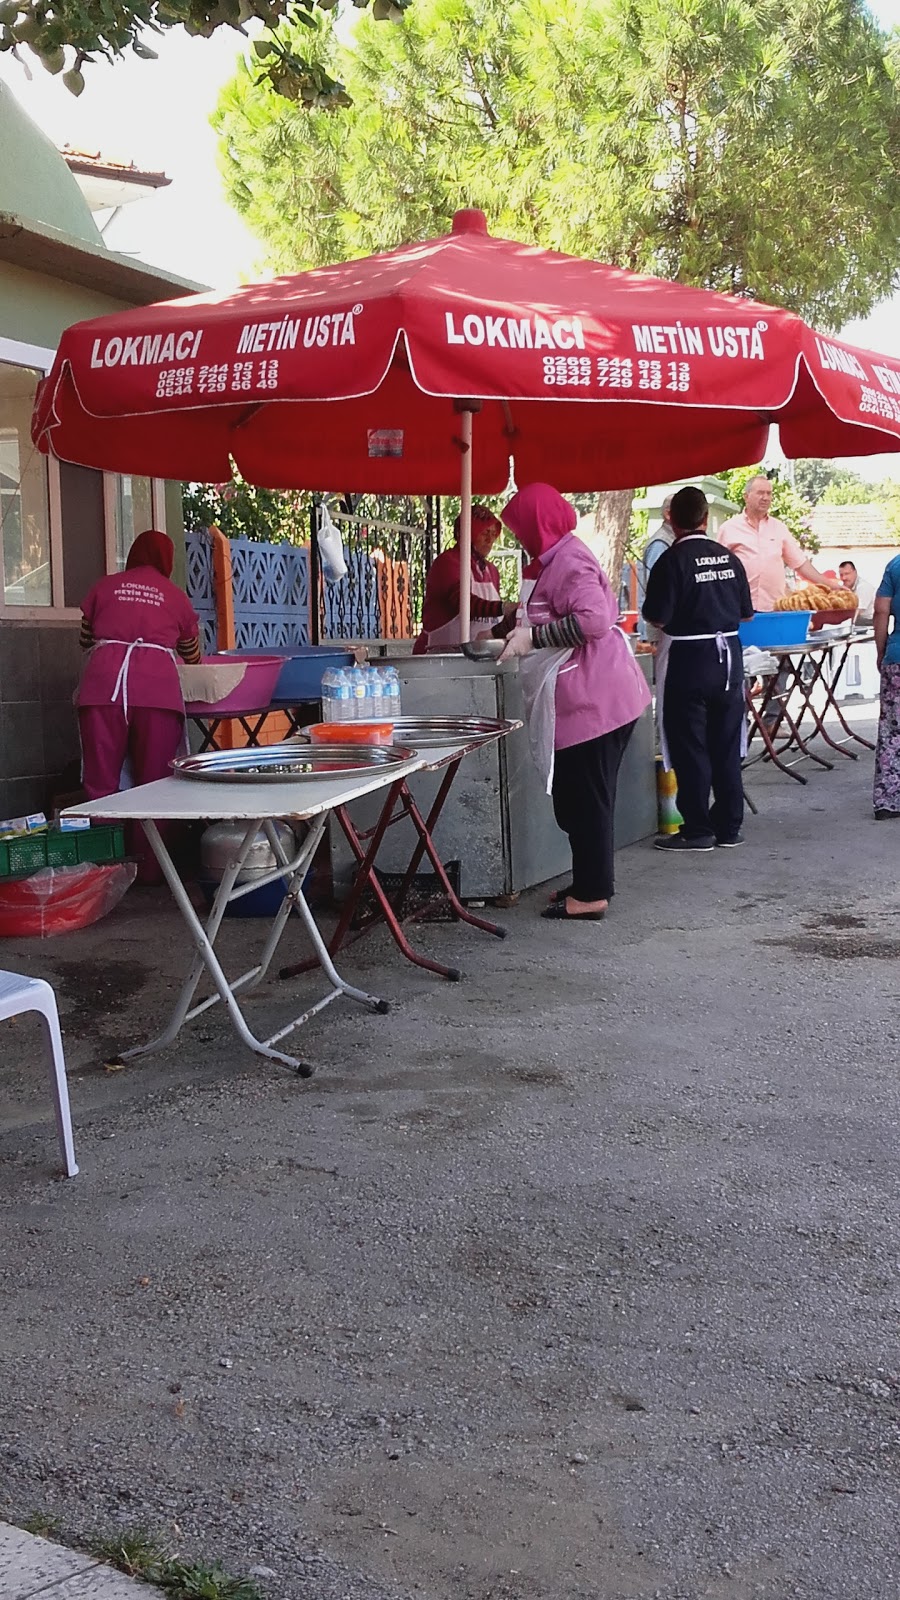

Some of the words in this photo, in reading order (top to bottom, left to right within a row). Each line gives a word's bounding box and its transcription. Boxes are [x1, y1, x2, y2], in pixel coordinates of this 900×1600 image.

[91, 330, 203, 368] LOKMACI
[237, 314, 301, 353] METİN
[445, 312, 585, 350] LOKMACI
[632, 321, 704, 355] METİN
[159, 367, 194, 380] 0266
[200, 364, 228, 375] 244
[234, 362, 253, 372] 95
[259, 360, 278, 369] 13
[543, 356, 591, 366] 0266
[597, 358, 633, 368] 244
[638, 359, 661, 370] 95
[668, 362, 690, 372] 13
[158, 376, 193, 388] 0535
[199, 373, 227, 384] 726
[233, 372, 252, 381] 13
[258, 370, 278, 379] 18
[544, 366, 591, 376] 0535
[597, 366, 633, 378] 726
[639, 370, 662, 380] 13
[668, 372, 690, 382] 18
[156, 385, 192, 398] 0544
[197, 382, 226, 393] 729
[231, 381, 251, 390] 56
[256, 380, 278, 389] 49
[544, 375, 591, 386] 0544
[597, 377, 633, 388] 729
[638, 379, 661, 390] 56
[666, 381, 689, 392] 49
[122, 583, 158, 592] LOKMACI
